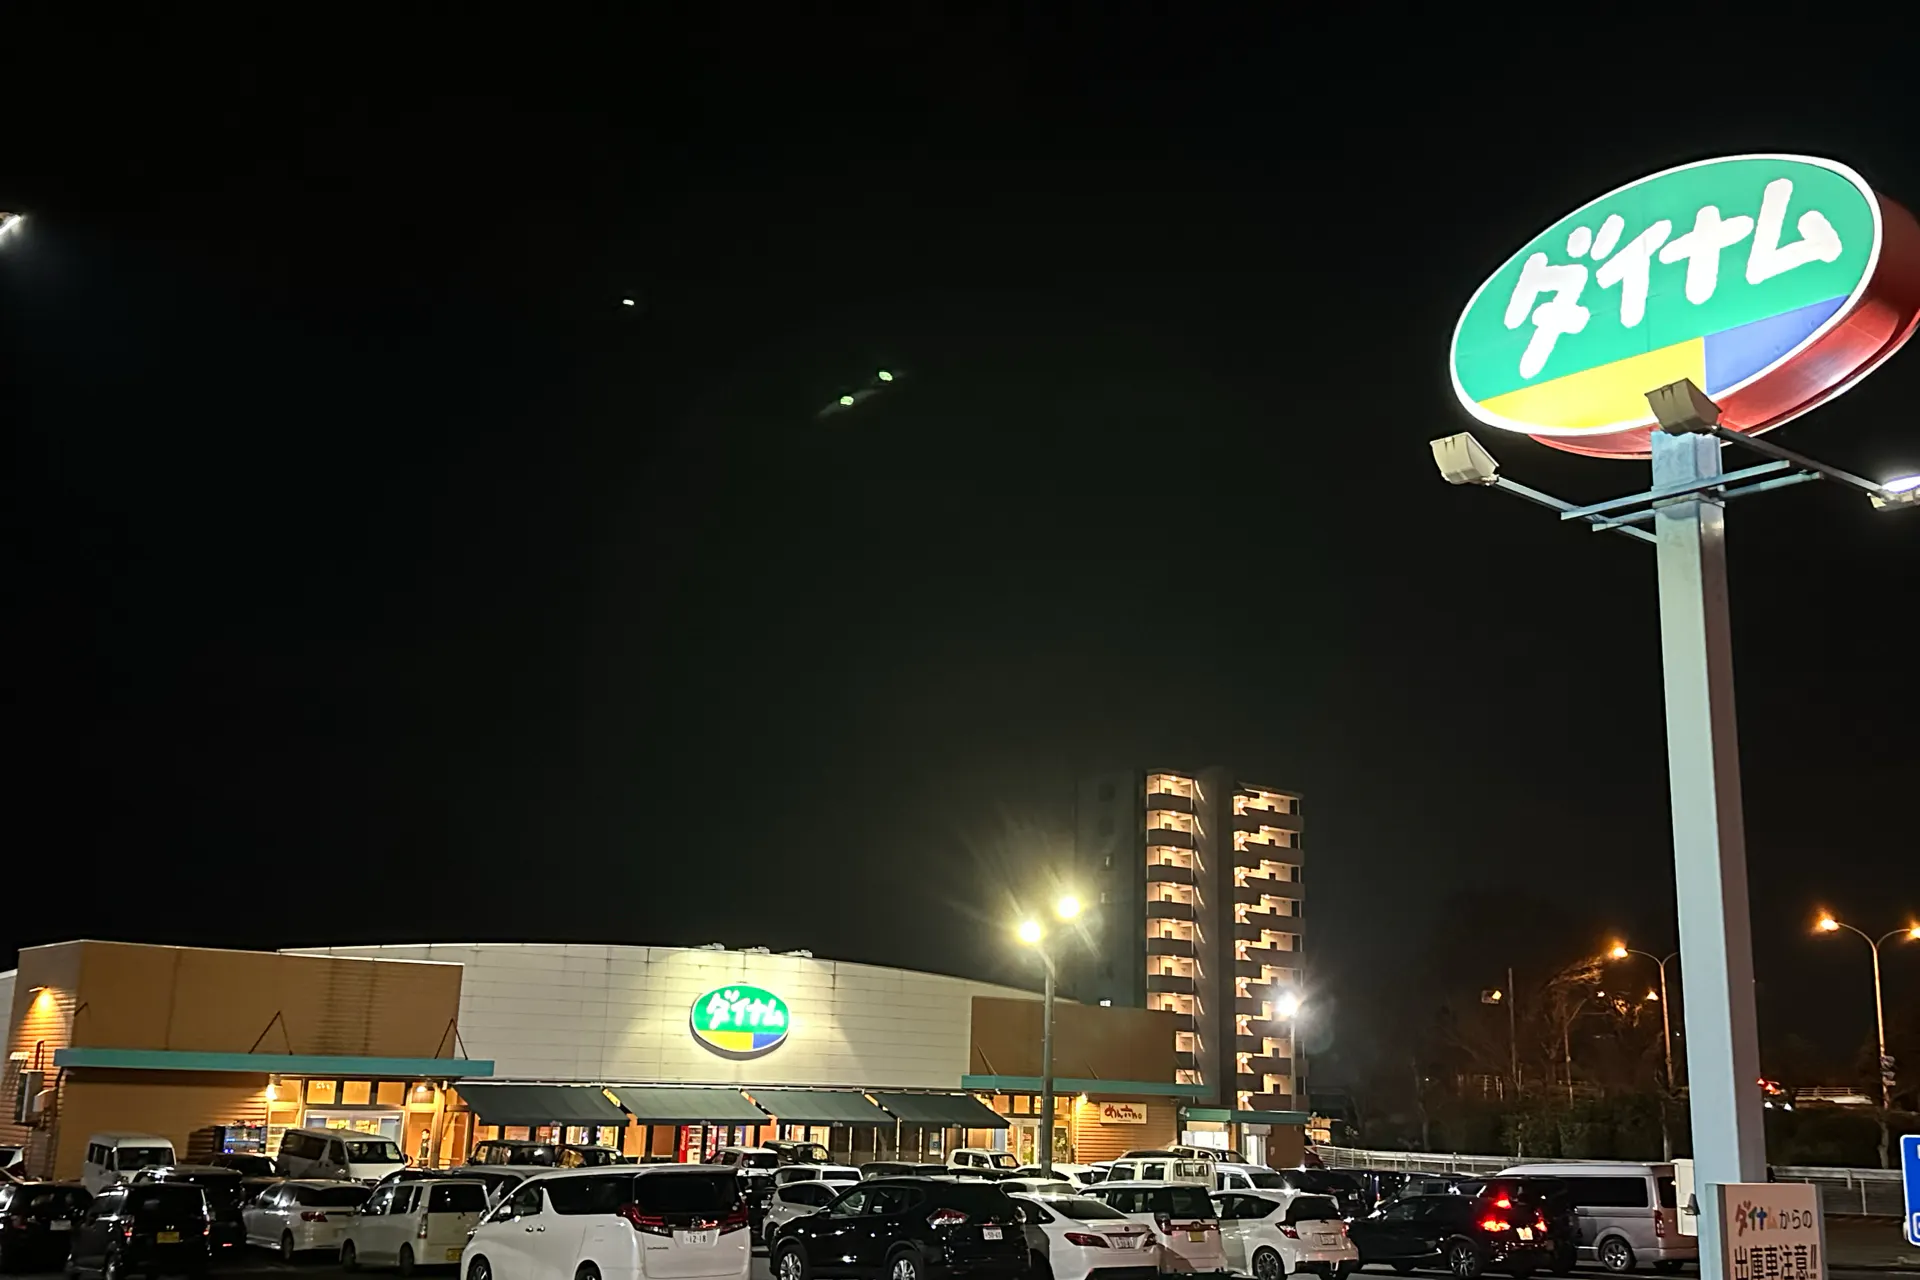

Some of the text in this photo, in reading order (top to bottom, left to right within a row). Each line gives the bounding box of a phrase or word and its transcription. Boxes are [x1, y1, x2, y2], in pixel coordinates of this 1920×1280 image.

[1504, 178, 1843, 379] ダイナム
[706, 989, 785, 1030] ダイナム
